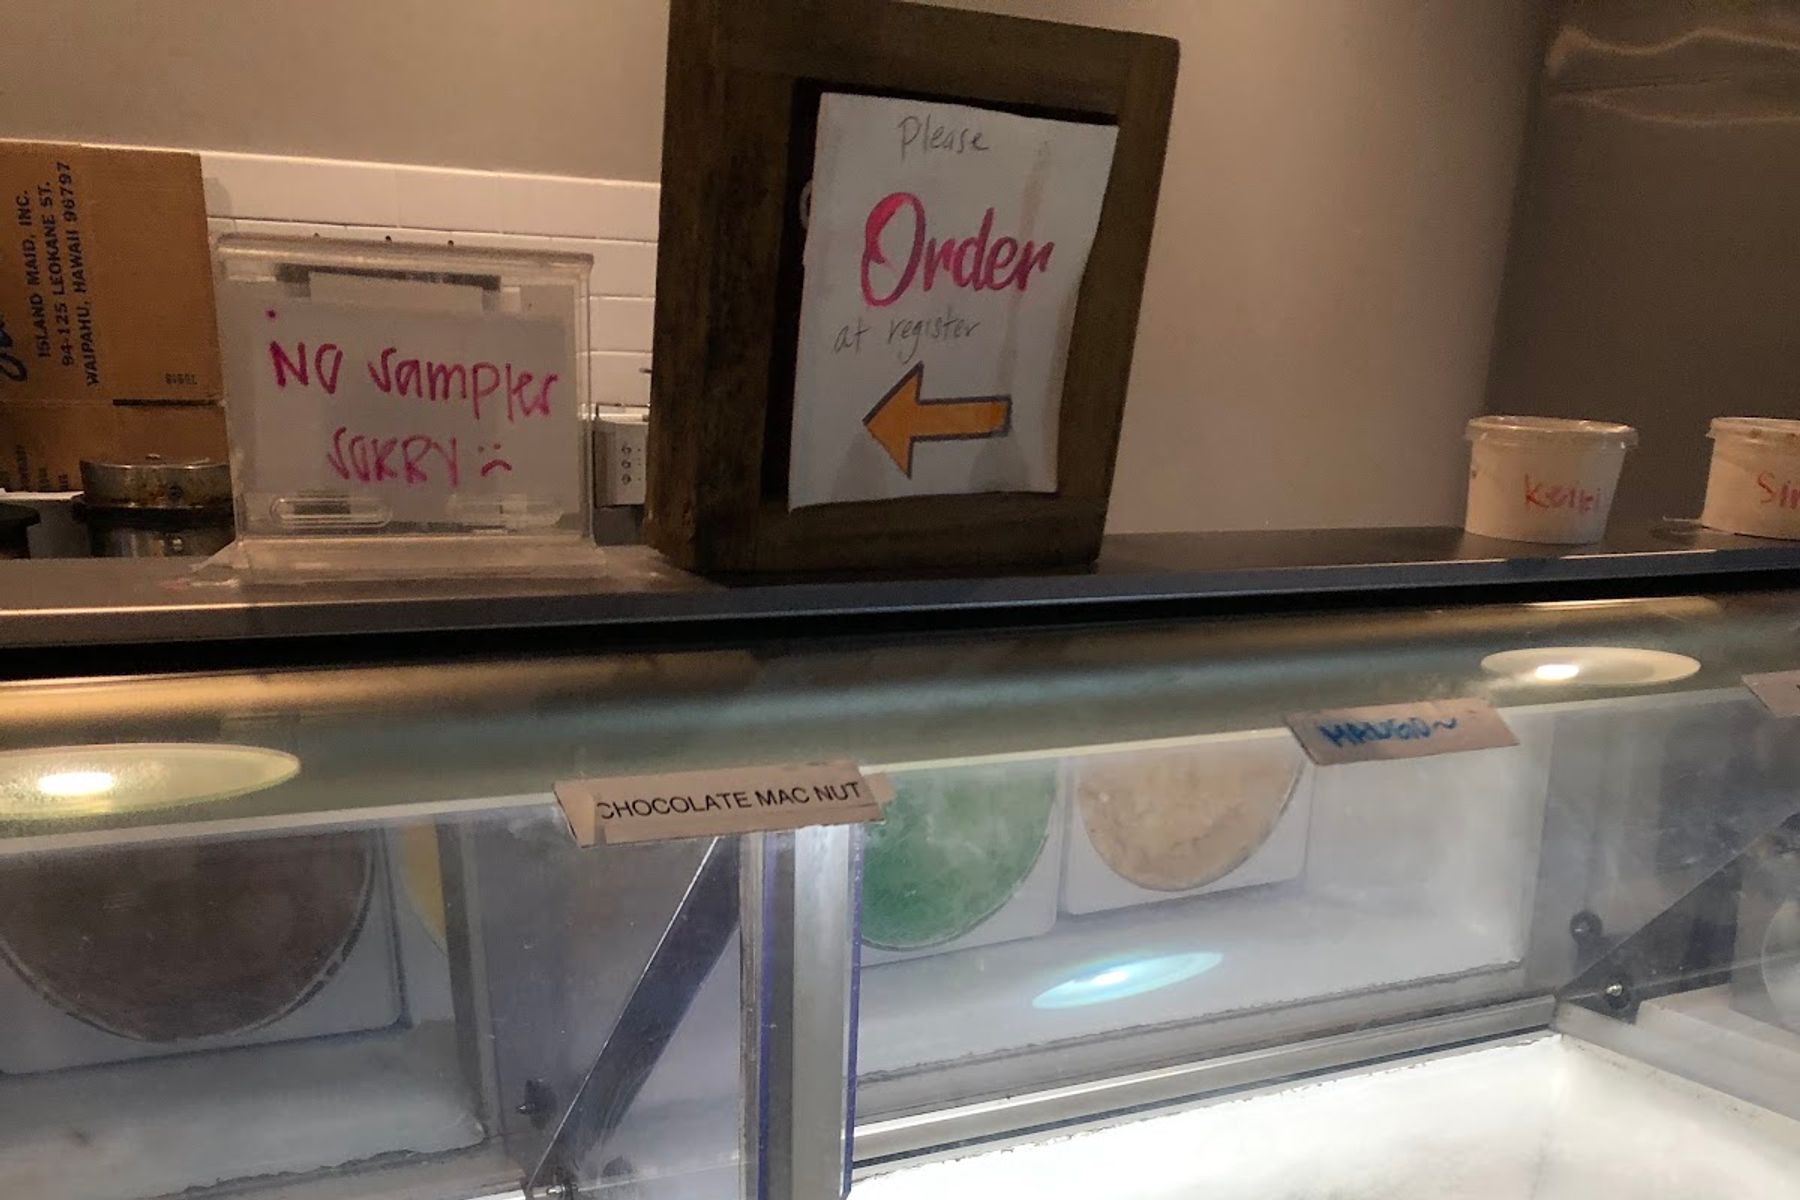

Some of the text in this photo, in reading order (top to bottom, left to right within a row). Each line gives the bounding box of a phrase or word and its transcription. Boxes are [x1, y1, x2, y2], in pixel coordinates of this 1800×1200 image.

[898, 114, 989, 160] Please
[16, 190, 32, 226] INC.
[37, 181, 75, 367] 94-125 LEOKANE ST.
[57, 161, 99, 388] WAIPAHU, HAWAII 96797
[861, 191, 1055, 307] Order
[30, 293, 51, 358] ISLAND
[834, 306, 981, 364] at register
[269, 340, 344, 395] NO
[596, 781, 862, 821] CHOCOLATE MAC NUT
